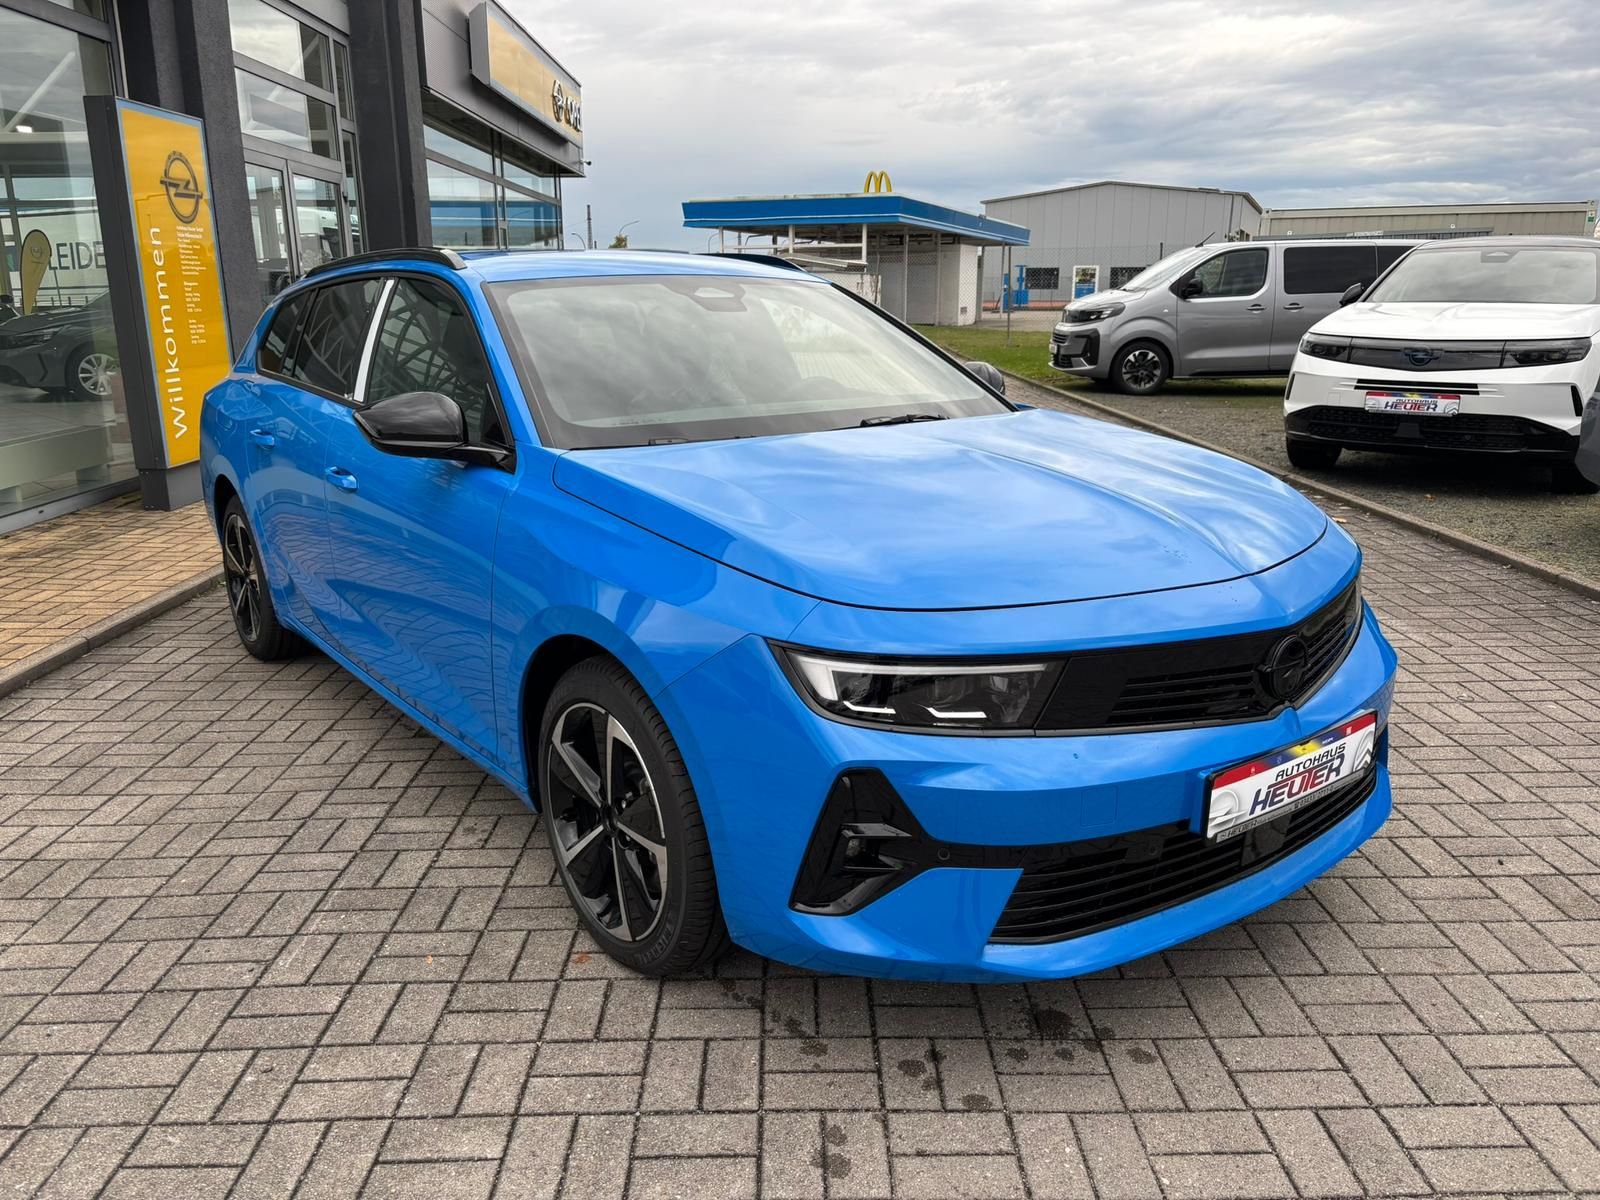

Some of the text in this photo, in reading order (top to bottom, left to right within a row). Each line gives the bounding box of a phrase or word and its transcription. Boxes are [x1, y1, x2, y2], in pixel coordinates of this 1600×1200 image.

[150, 227, 188, 439] Willkommen
[1384, 401, 1438, 411] HEUTER
[1249, 753, 1345, 816] HEUTER
[1275, 743, 1346, 781] AUTOHAUS
